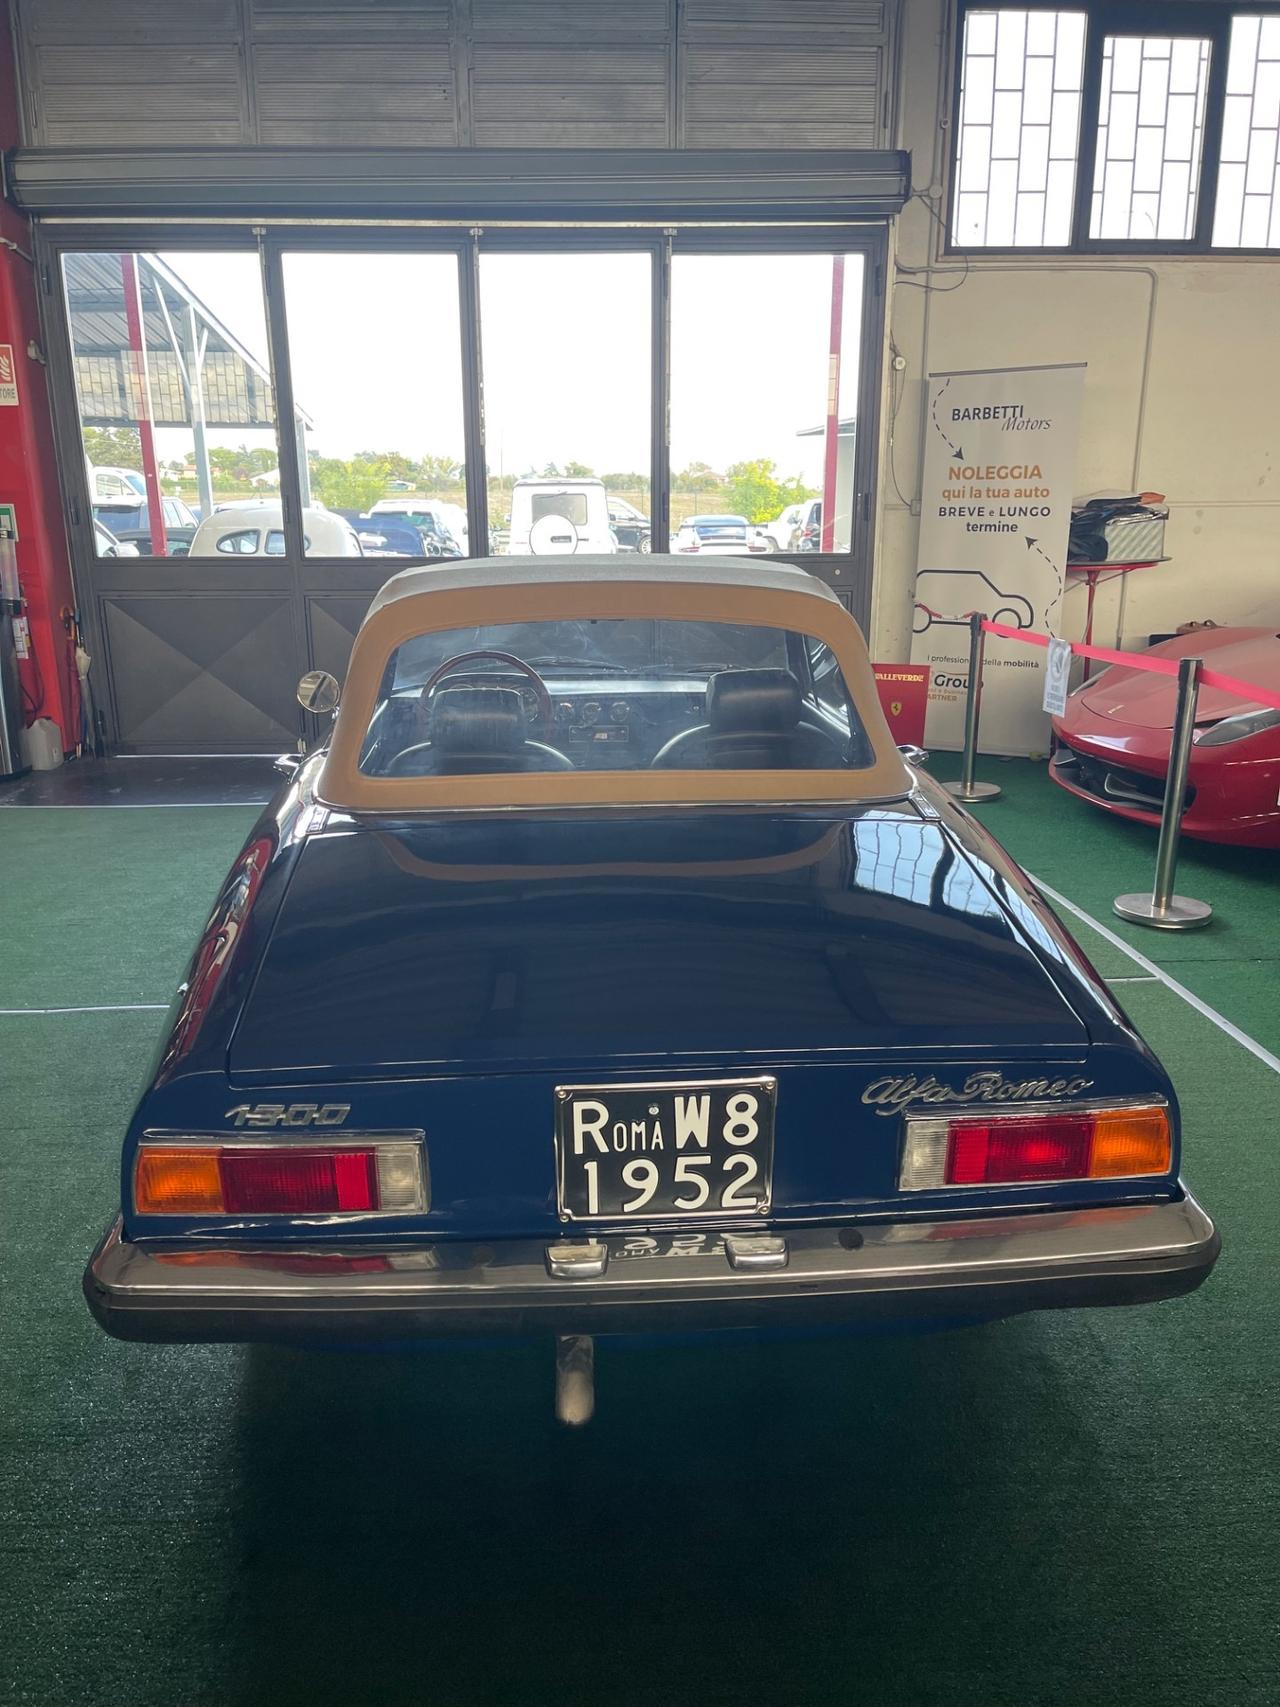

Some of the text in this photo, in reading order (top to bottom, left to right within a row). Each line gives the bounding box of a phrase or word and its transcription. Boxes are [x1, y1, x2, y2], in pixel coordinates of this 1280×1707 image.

[951, 405, 1024, 421] BARBETTI
[1001, 416, 1052, 432] Motors
[948, 465, 1042, 481] NOLEGGIA
[942, 486, 1050, 501] qui la tua auto
[938, 506, 1051, 517] BREVE e LUNGO
[966, 520, 1018, 533] termine
[931, 655, 971, 664] profession
[860, 1070, 1095, 1116] Alfa Romeo
[583, 1153, 759, 1215] 1952
